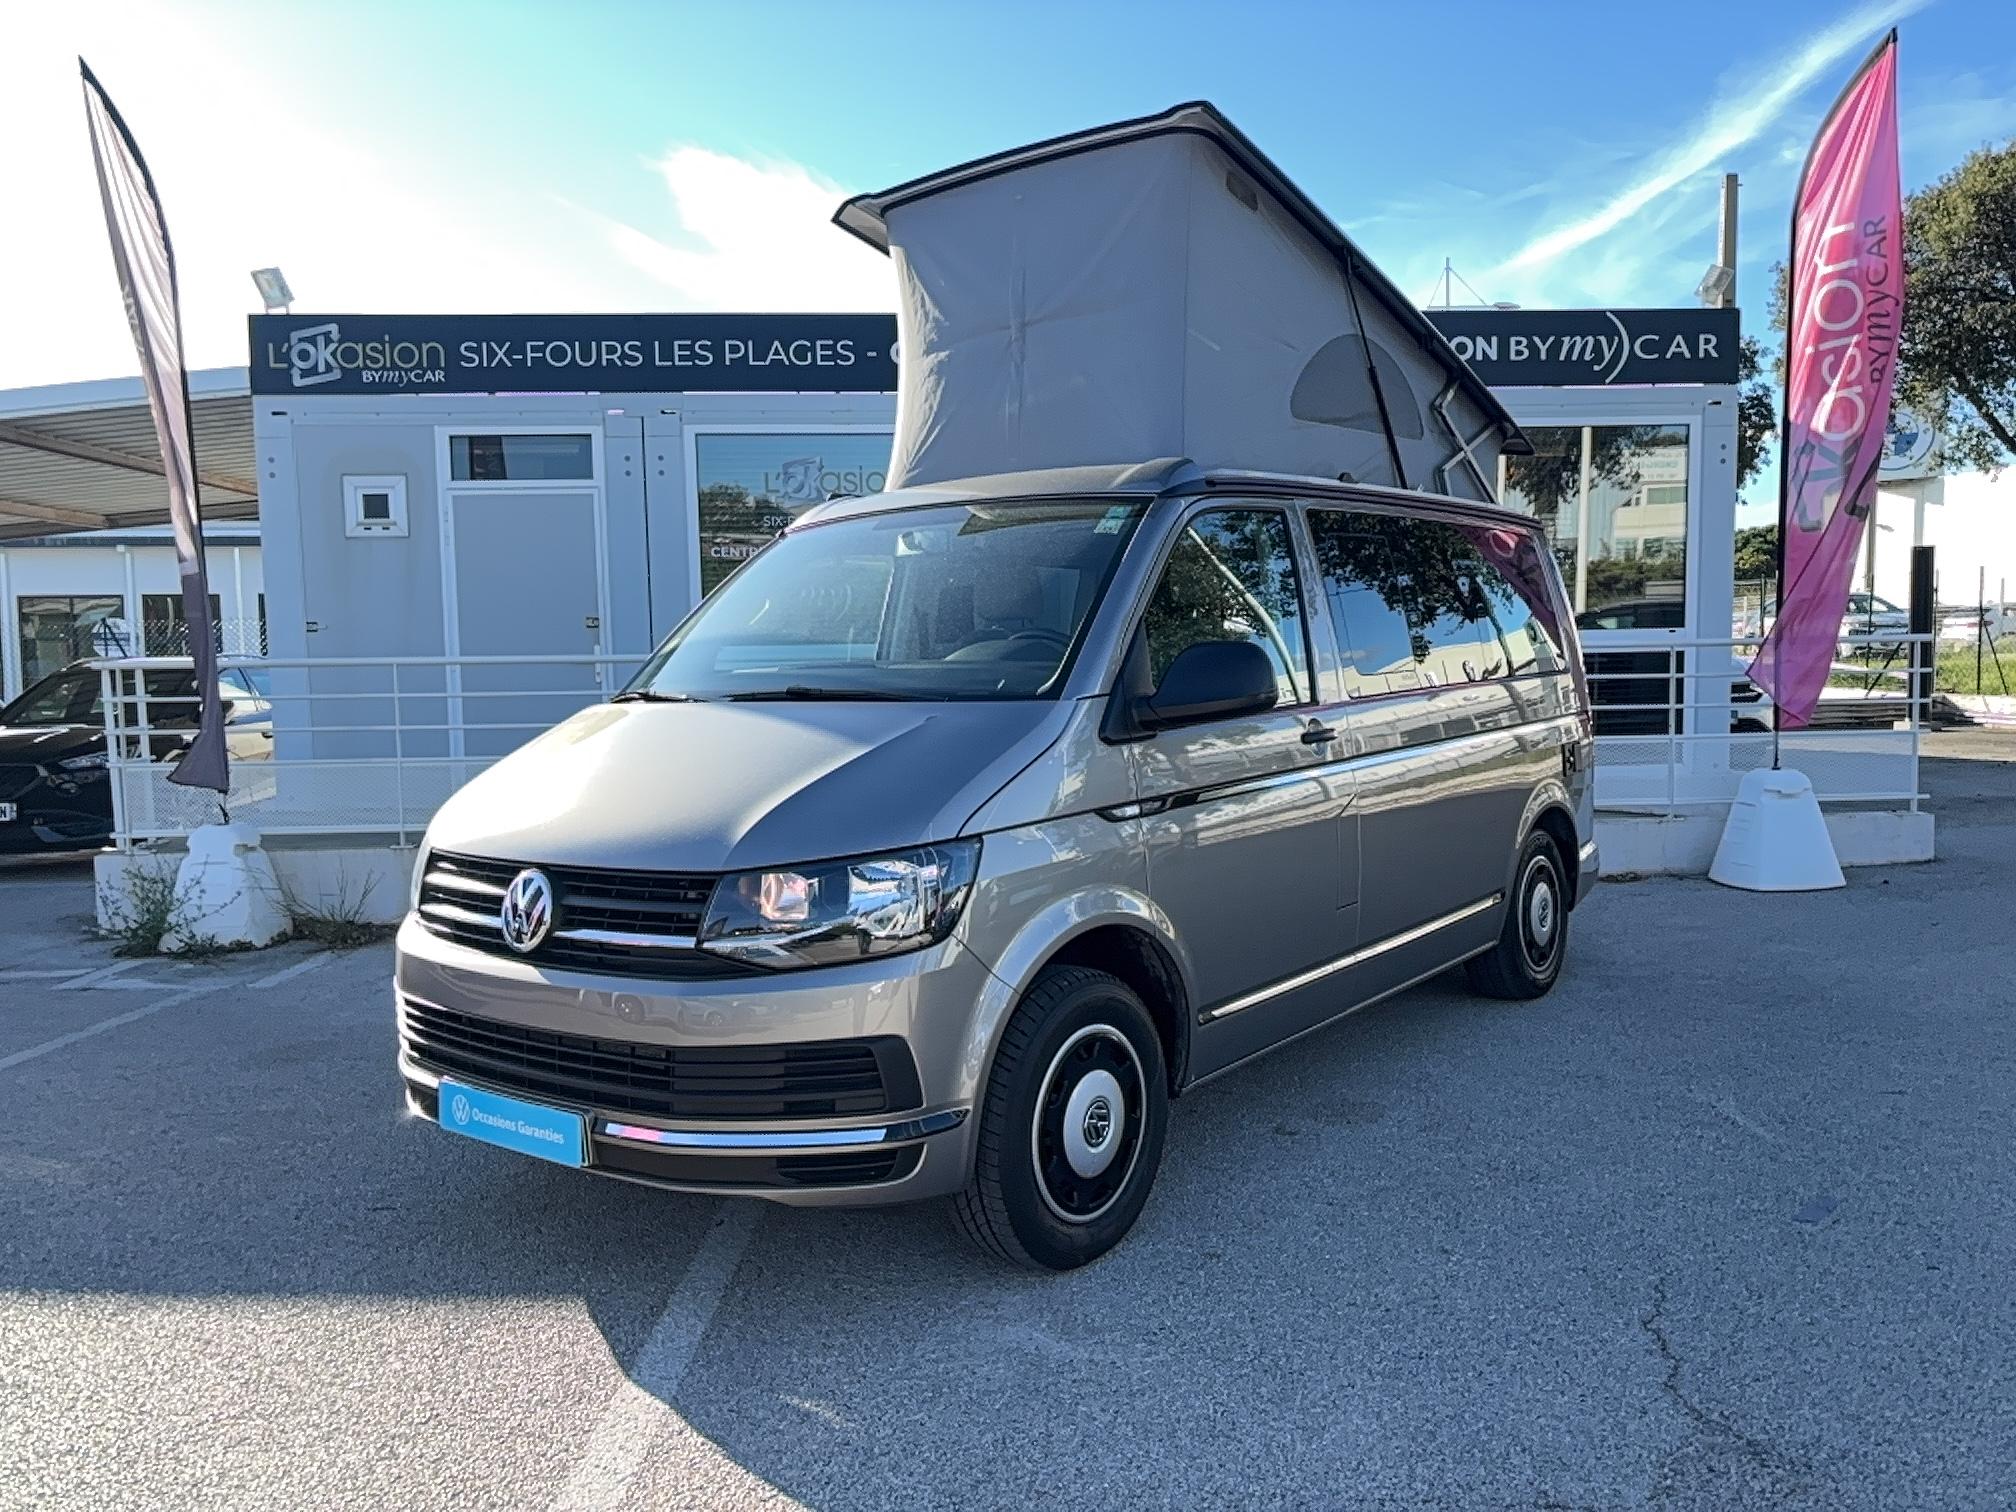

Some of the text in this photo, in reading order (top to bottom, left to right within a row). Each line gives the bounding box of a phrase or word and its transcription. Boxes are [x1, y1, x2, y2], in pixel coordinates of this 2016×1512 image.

[459, 340, 644, 368] SIX-FOURS
[654, 340, 713, 366] LES
[724, 339, 855, 367] PLAGES
[1451, 335, 1498, 361] ON
[763, 515, 797, 527] SIX-F
[472, 1108, 516, 1131] Occasions
[517, 1120, 565, 1145] Garanties
